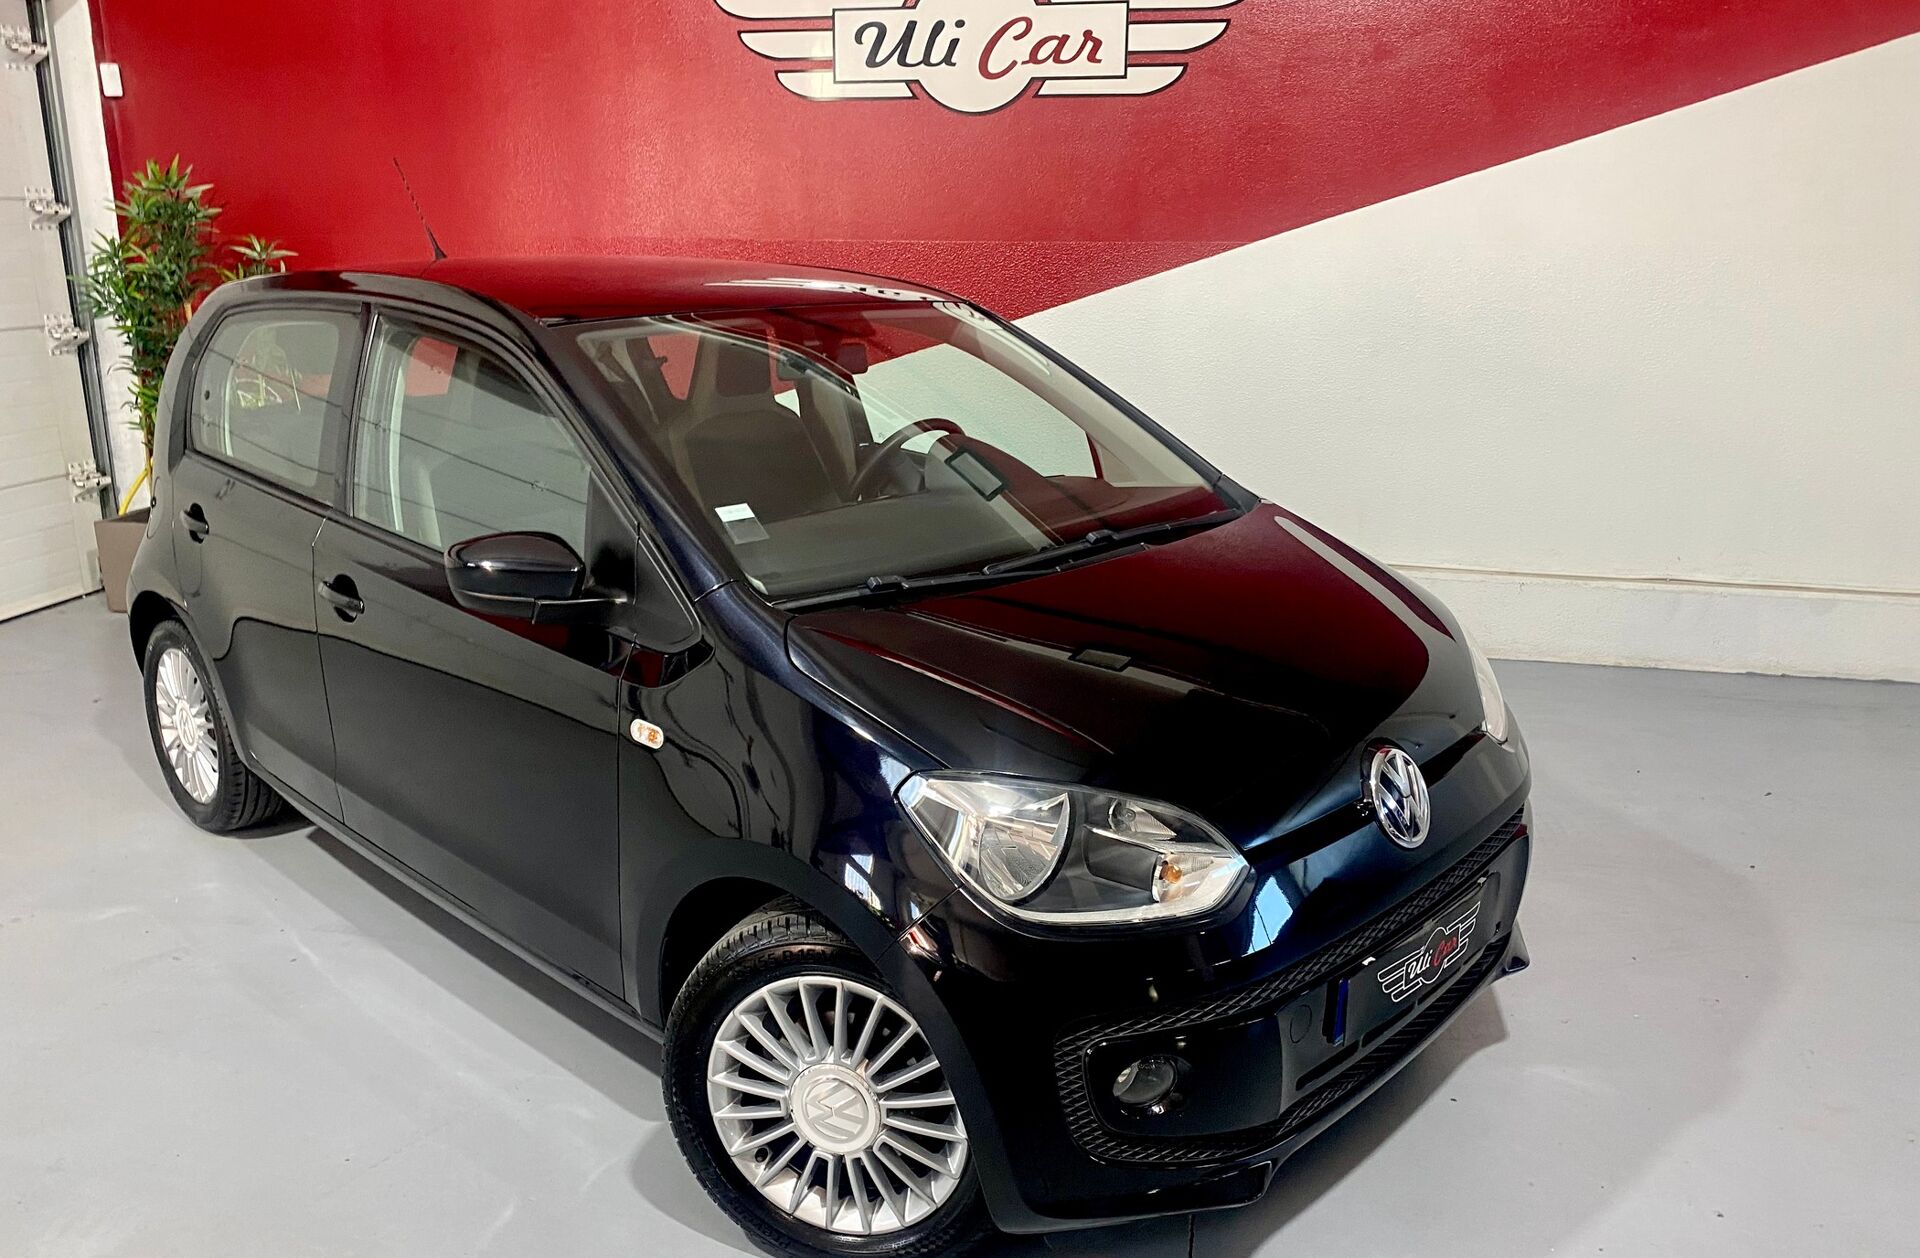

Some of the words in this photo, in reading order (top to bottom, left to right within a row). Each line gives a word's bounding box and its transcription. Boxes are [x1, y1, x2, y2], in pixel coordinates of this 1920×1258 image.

[854, 19, 966, 68] Uli
[978, 16, 1103, 80] Car
[1431, 937, 1457, 966] Car
